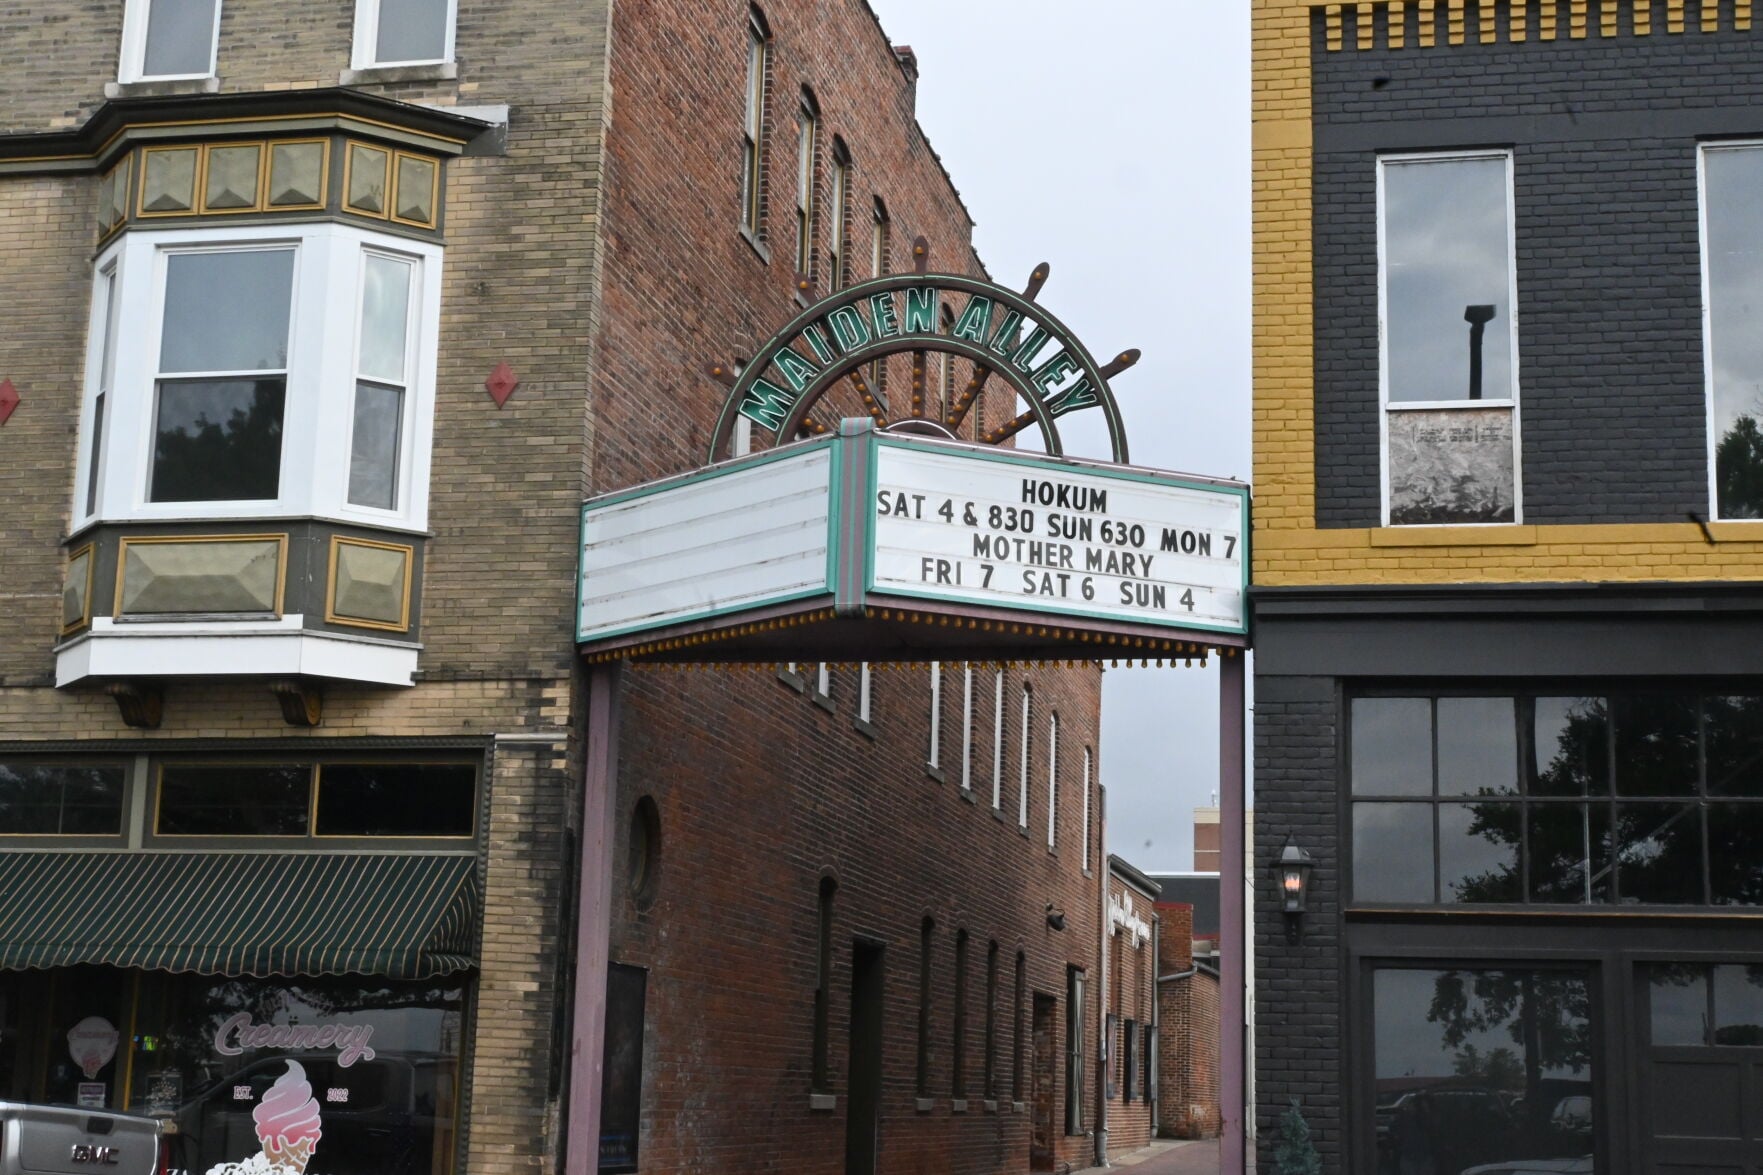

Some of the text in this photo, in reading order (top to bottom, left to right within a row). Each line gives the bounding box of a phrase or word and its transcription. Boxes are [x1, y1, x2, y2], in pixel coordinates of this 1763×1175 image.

[737, 286, 1102, 432] MAIDEN ALLEY
[1021, 478, 1108, 514] HOKUM
[877, 489, 1237, 559] SAT 4 & 830 SUN 630 MON 7
[972, 533, 1154, 578] MOTHER MARY
[921, 557, 1195, 612] FRI 7 SAT 6 SUN 4
[215, 1012, 376, 1068] Creamery
[327, 1088, 349, 1102] 2022
[72, 1144, 119, 1165] GMC
